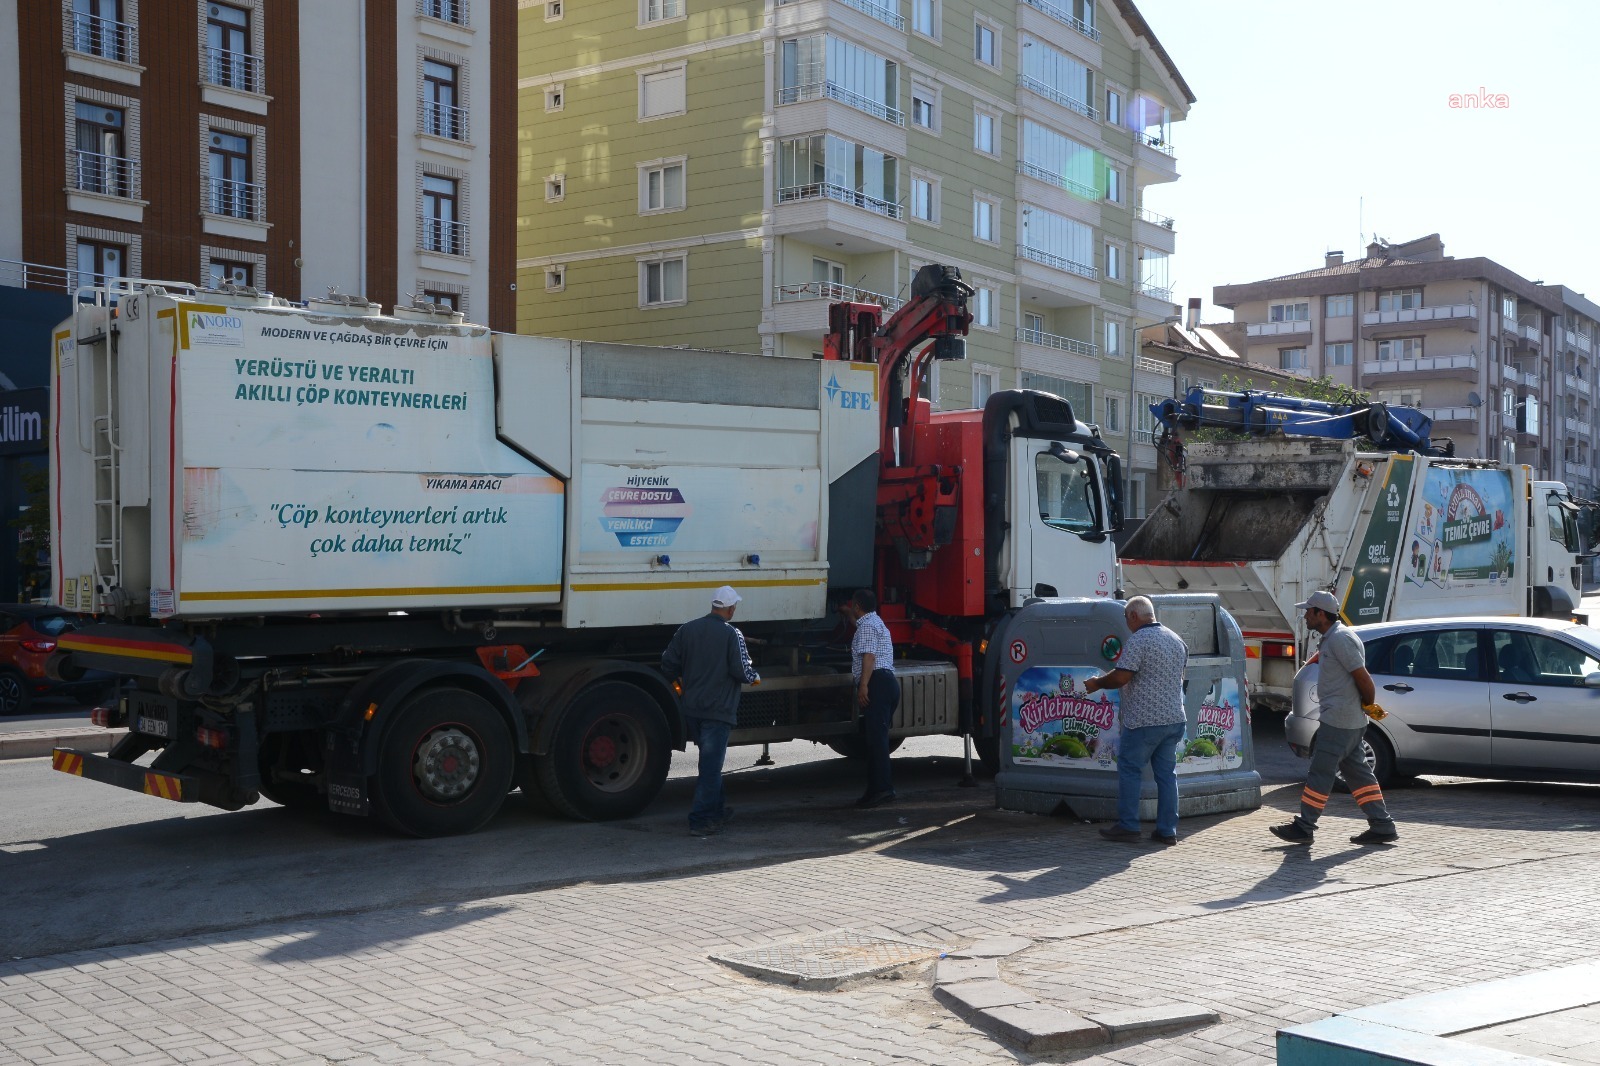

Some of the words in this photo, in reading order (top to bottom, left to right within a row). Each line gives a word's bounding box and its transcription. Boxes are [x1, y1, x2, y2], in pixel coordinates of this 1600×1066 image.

[204, 315, 242, 329] NORD
[261, 327, 311, 340] MODERN
[313, 331, 327, 341] VE
[329, 332, 373, 346] ÇAĞDAŞ
[375, 334, 391, 346] BİR
[393, 338, 426, 348] ÇEVRE
[428, 338, 448, 351] İÇİN
[235, 358, 317, 379] YERÜSTÜ
[322, 364, 344, 381] VE
[348, 366, 415, 385] YERALTI
[235, 384, 292, 402] AKILLI
[296, 384, 330, 406] ÇÖP
[334, 388, 467, 410] KONTEYNERLERİ
[840, 390, 872, 410] EFE
[426, 479, 468, 490] YIKAMA
[469, 479, 502, 490] ARACI
[626, 475, 669, 487] HİJYENİK
[608, 491, 639, 503] ÇEVRE
[640, 491, 673, 501] DOSTU
[271, 503, 319, 529] "Çöp
[324, 505, 458, 529] konteynerleri
[462, 506, 508, 524] artık
[607, 518, 654, 532] YENİLİKÇİ
[630, 535, 669, 546] ESTETİK
[1444, 521, 1468, 542] TEMİZ
[1468, 519, 1490, 542] ÇEVRE
[310, 533, 347, 558] çok
[351, 533, 404, 553] daha
[409, 532, 472, 555] temiz"
[1368, 540, 1387, 560] geri
[1021, 697, 1112, 730] Kirletmemek
[1064, 718, 1100, 737] Elimizde
